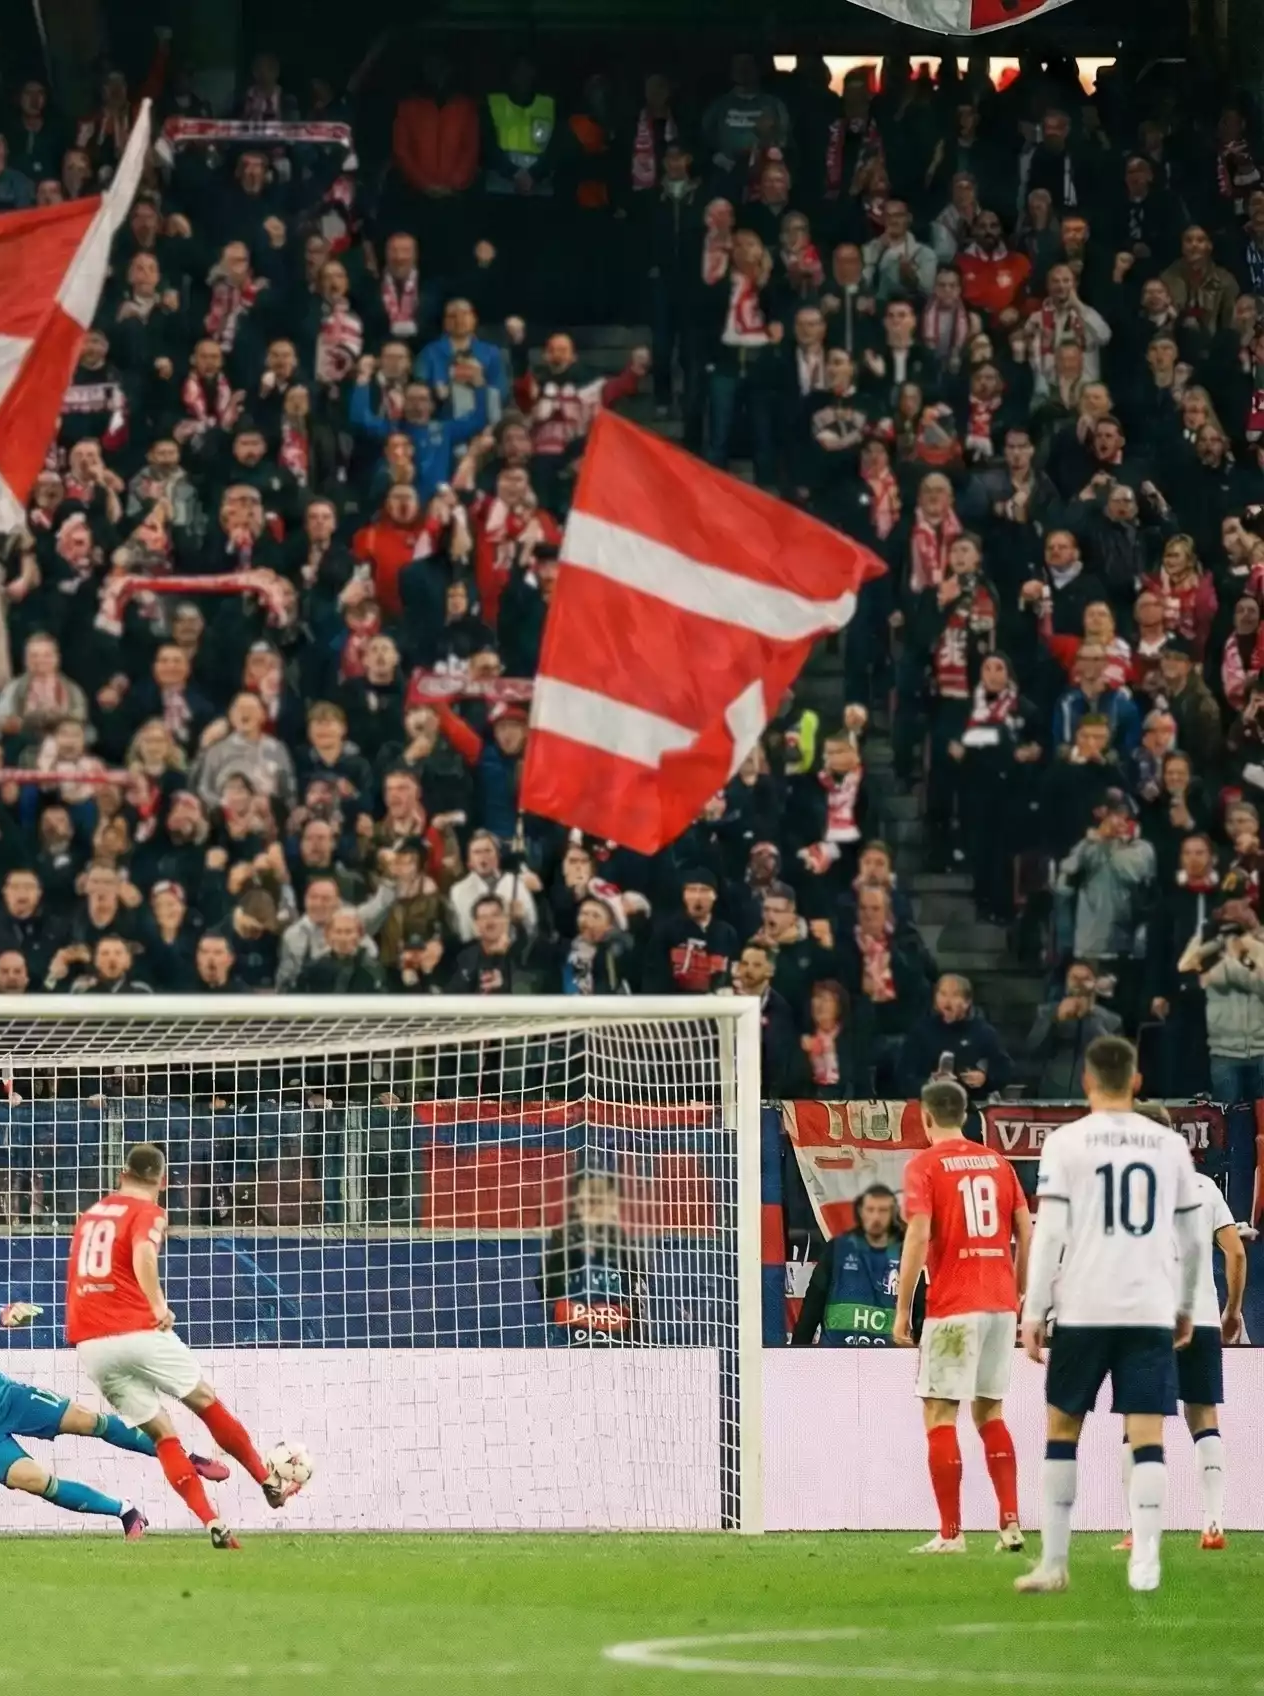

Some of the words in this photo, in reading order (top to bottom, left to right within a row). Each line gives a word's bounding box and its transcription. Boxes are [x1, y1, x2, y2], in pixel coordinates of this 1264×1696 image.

[957, 1175, 998, 1238] 18
[1095, 1161, 1156, 1237] 10
[77, 1218, 116, 1278] 18
[853, 1307, 886, 1331] HC
